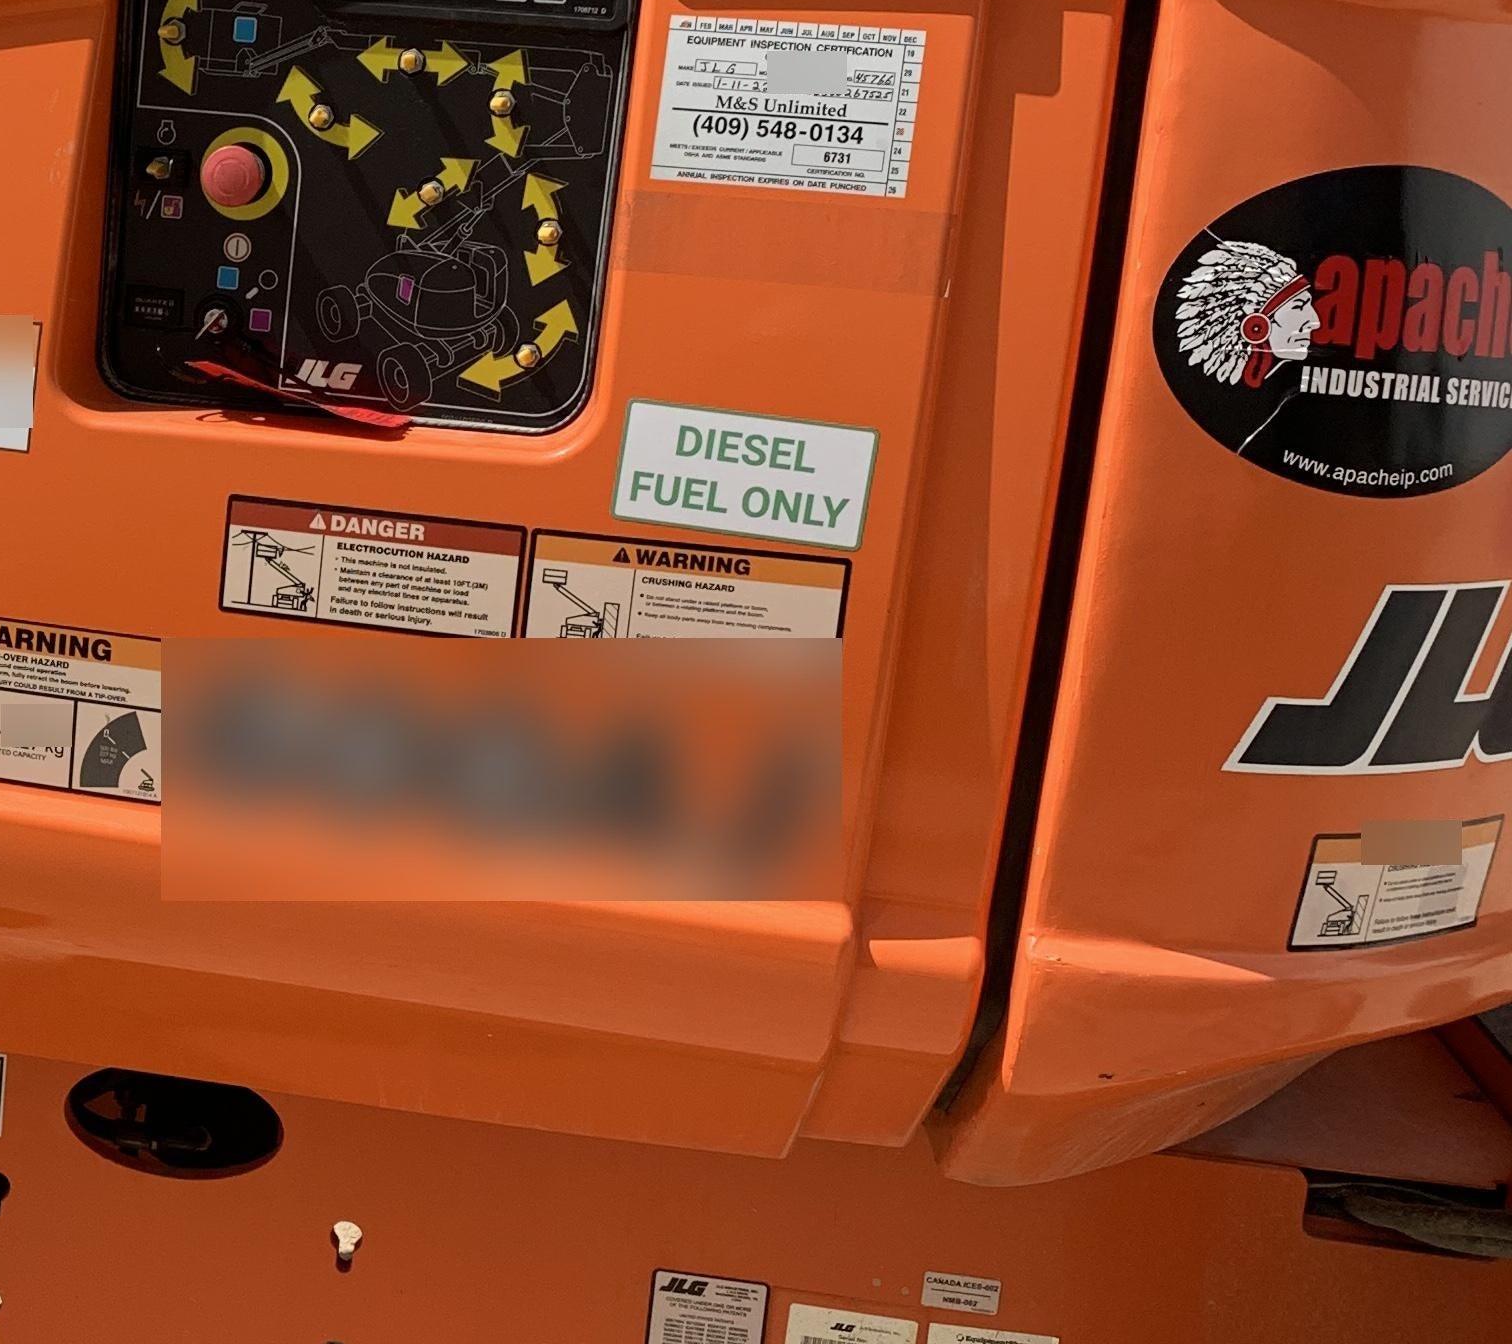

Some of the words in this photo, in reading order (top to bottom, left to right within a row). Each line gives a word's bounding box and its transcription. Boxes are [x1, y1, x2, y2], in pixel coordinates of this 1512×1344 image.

[687, 36, 746, 47] EQUIPMENT
[751, 40, 811, 51] INSPECTION
[817, 44, 893, 57] CERTIFICATION
[715, 96, 758, 111] M&S
[764, 98, 847, 117] Unlimited
[693, 114, 749, 141] (409)
[756, 119, 863, 144] 548-0134
[824, 152, 851, 164] 6731
[677, 171, 706, 179] ANNUAL
[711, 173, 754, 183] INSPECTION
[758, 177, 789, 185] EXPIRES
[830, 183, 866, 191] PUNCHED
[807, 168, 852, 177] CERTIFICATION
[1310, 250, 1512, 360] apach
[295, 359, 363, 390] JLG
[1300, 366, 1441, 404] INDUSTRIAL
[1445, 376, 1512, 409] SERVIC
[675, 425, 815, 474] DIESEL
[1283, 450, 1453, 489] www.apacheip.com
[630, 470, 727, 514] FUEL
[742, 486, 850, 529] ONLY
[330, 514, 425, 541] DANGER
[337, 542, 424, 558] ELECTROCUTION
[427, 552, 470, 564] HAZARD
[636, 548, 751, 576] WARNING
[341, 556, 356, 564] This
[358, 559, 388, 568] machine
[412, 564, 447, 574] insulated.
[340, 567, 370, 576] Maintain
[378, 572, 413, 581] clearance
[434, 578, 451, 586] least
[642, 577, 692, 588] CRUSHING
[695, 582, 735, 593] HAZARD
[330, 596, 358, 605] Failure
[371, 600, 395, 610] follow
[398, 602, 446, 616] instructions
[448, 610, 462, 618] will
[464, 612, 488, 620] result
[340, 608, 362, 616] death
[376, 612, 405, 621] serious
[408, 615, 432, 625] injury.
[31, 657, 69, 669] HAZARD
[14, 681, 37, 689] COULD
[39, 684, 64, 693] RESULT
[12, 751, 46, 760] CAPACITY
[659, 1277, 708, 1296] JLG
[926, 1277, 960, 1288] CANADA
[830, 1323, 856, 1332] JLG
